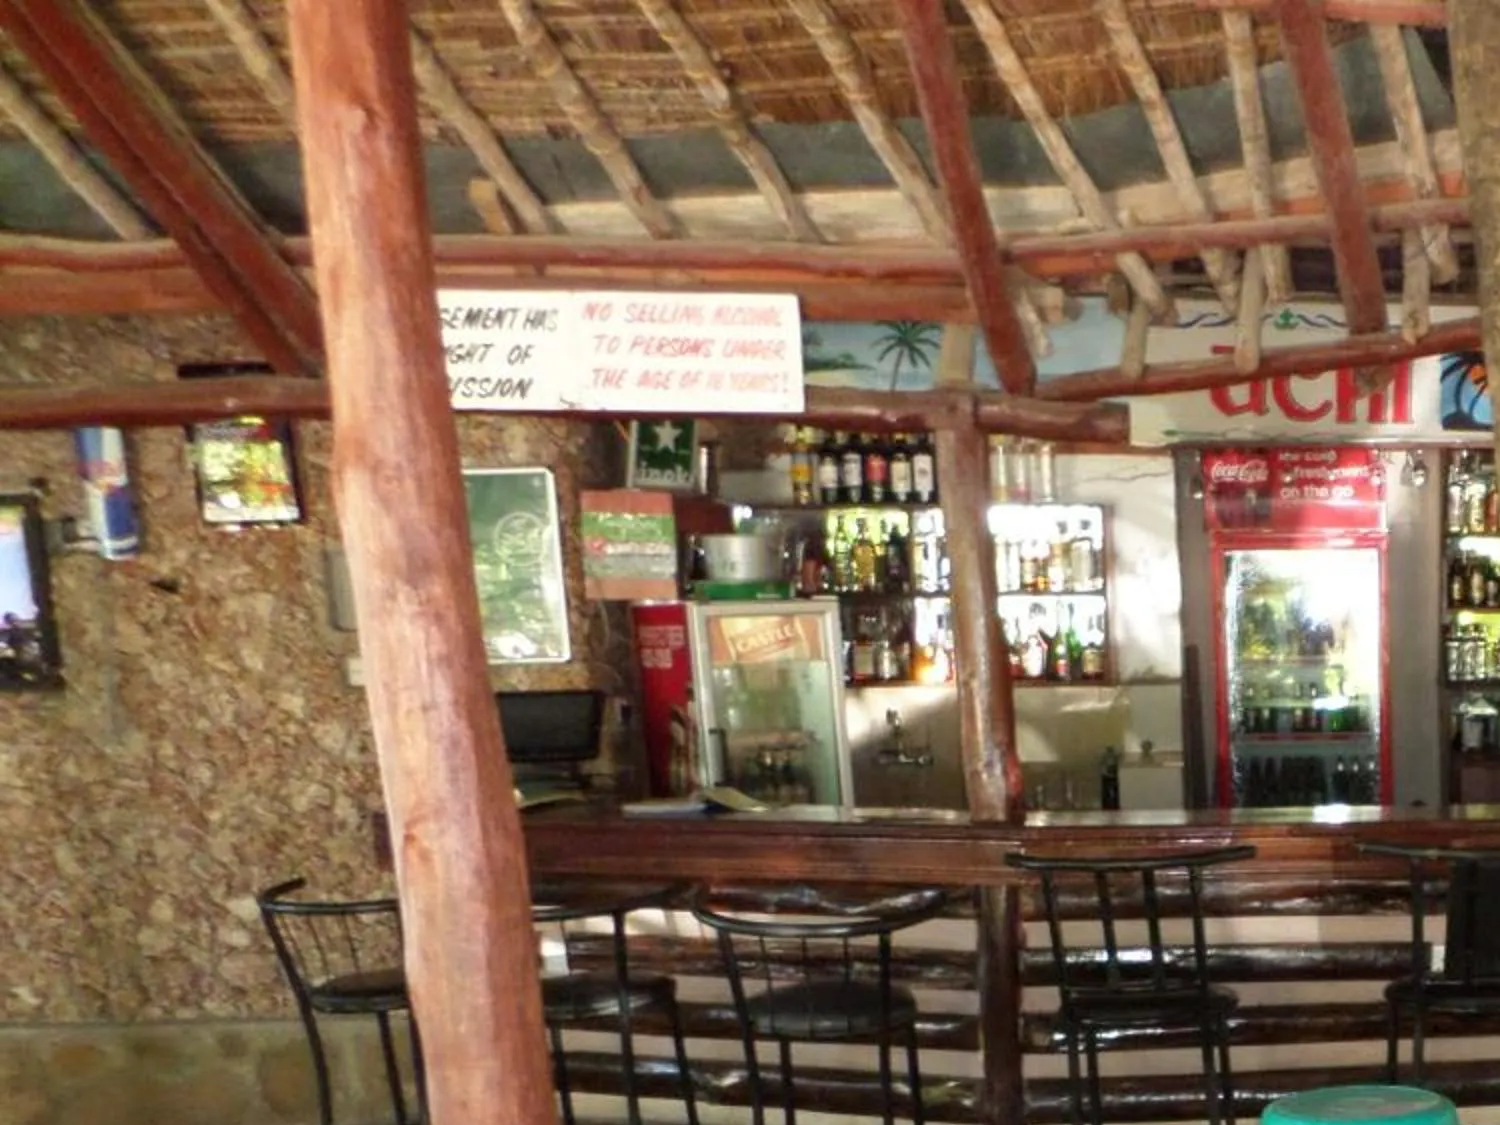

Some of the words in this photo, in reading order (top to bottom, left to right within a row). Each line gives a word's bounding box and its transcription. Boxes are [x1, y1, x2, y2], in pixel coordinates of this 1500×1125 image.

[582, 302, 613, 321] NO
[507, 343, 534, 366] OF
[592, 334, 621, 354] TO
[629, 335, 715, 358] PERSONS
[453, 376, 533, 400] ISSION
[591, 368, 627, 390] THE
[1280, 486, 1301, 498] on
[1303, 484, 1329, 498] the
[1331, 485, 1355, 501] go
